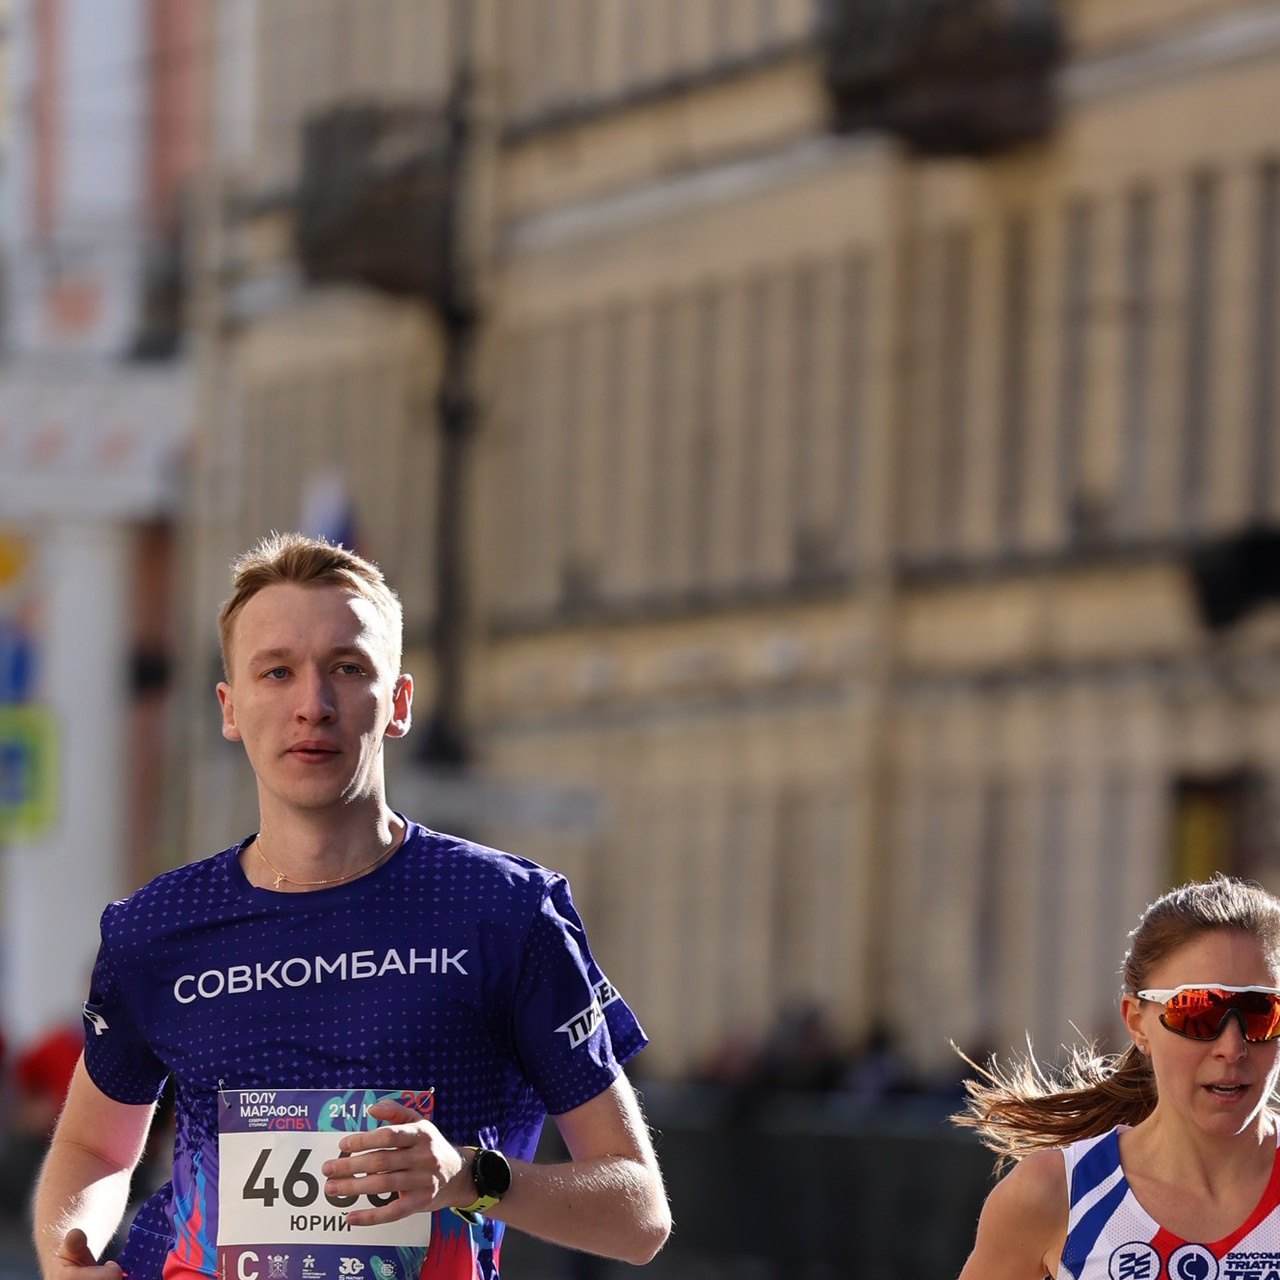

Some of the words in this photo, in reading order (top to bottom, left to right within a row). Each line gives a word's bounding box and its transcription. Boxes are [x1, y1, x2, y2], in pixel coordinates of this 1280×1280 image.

[173, 948, 469, 1004] СОВКОМБАНК
[240, 1092, 277, 1105] ПОЛУ
[240, 1105, 309, 1118] МАРАФОН
[329, 1103, 357, 1120] 21,1
[362, 1103, 374, 1118] К
[290, 1212, 352, 1232] ЮРИЙ
